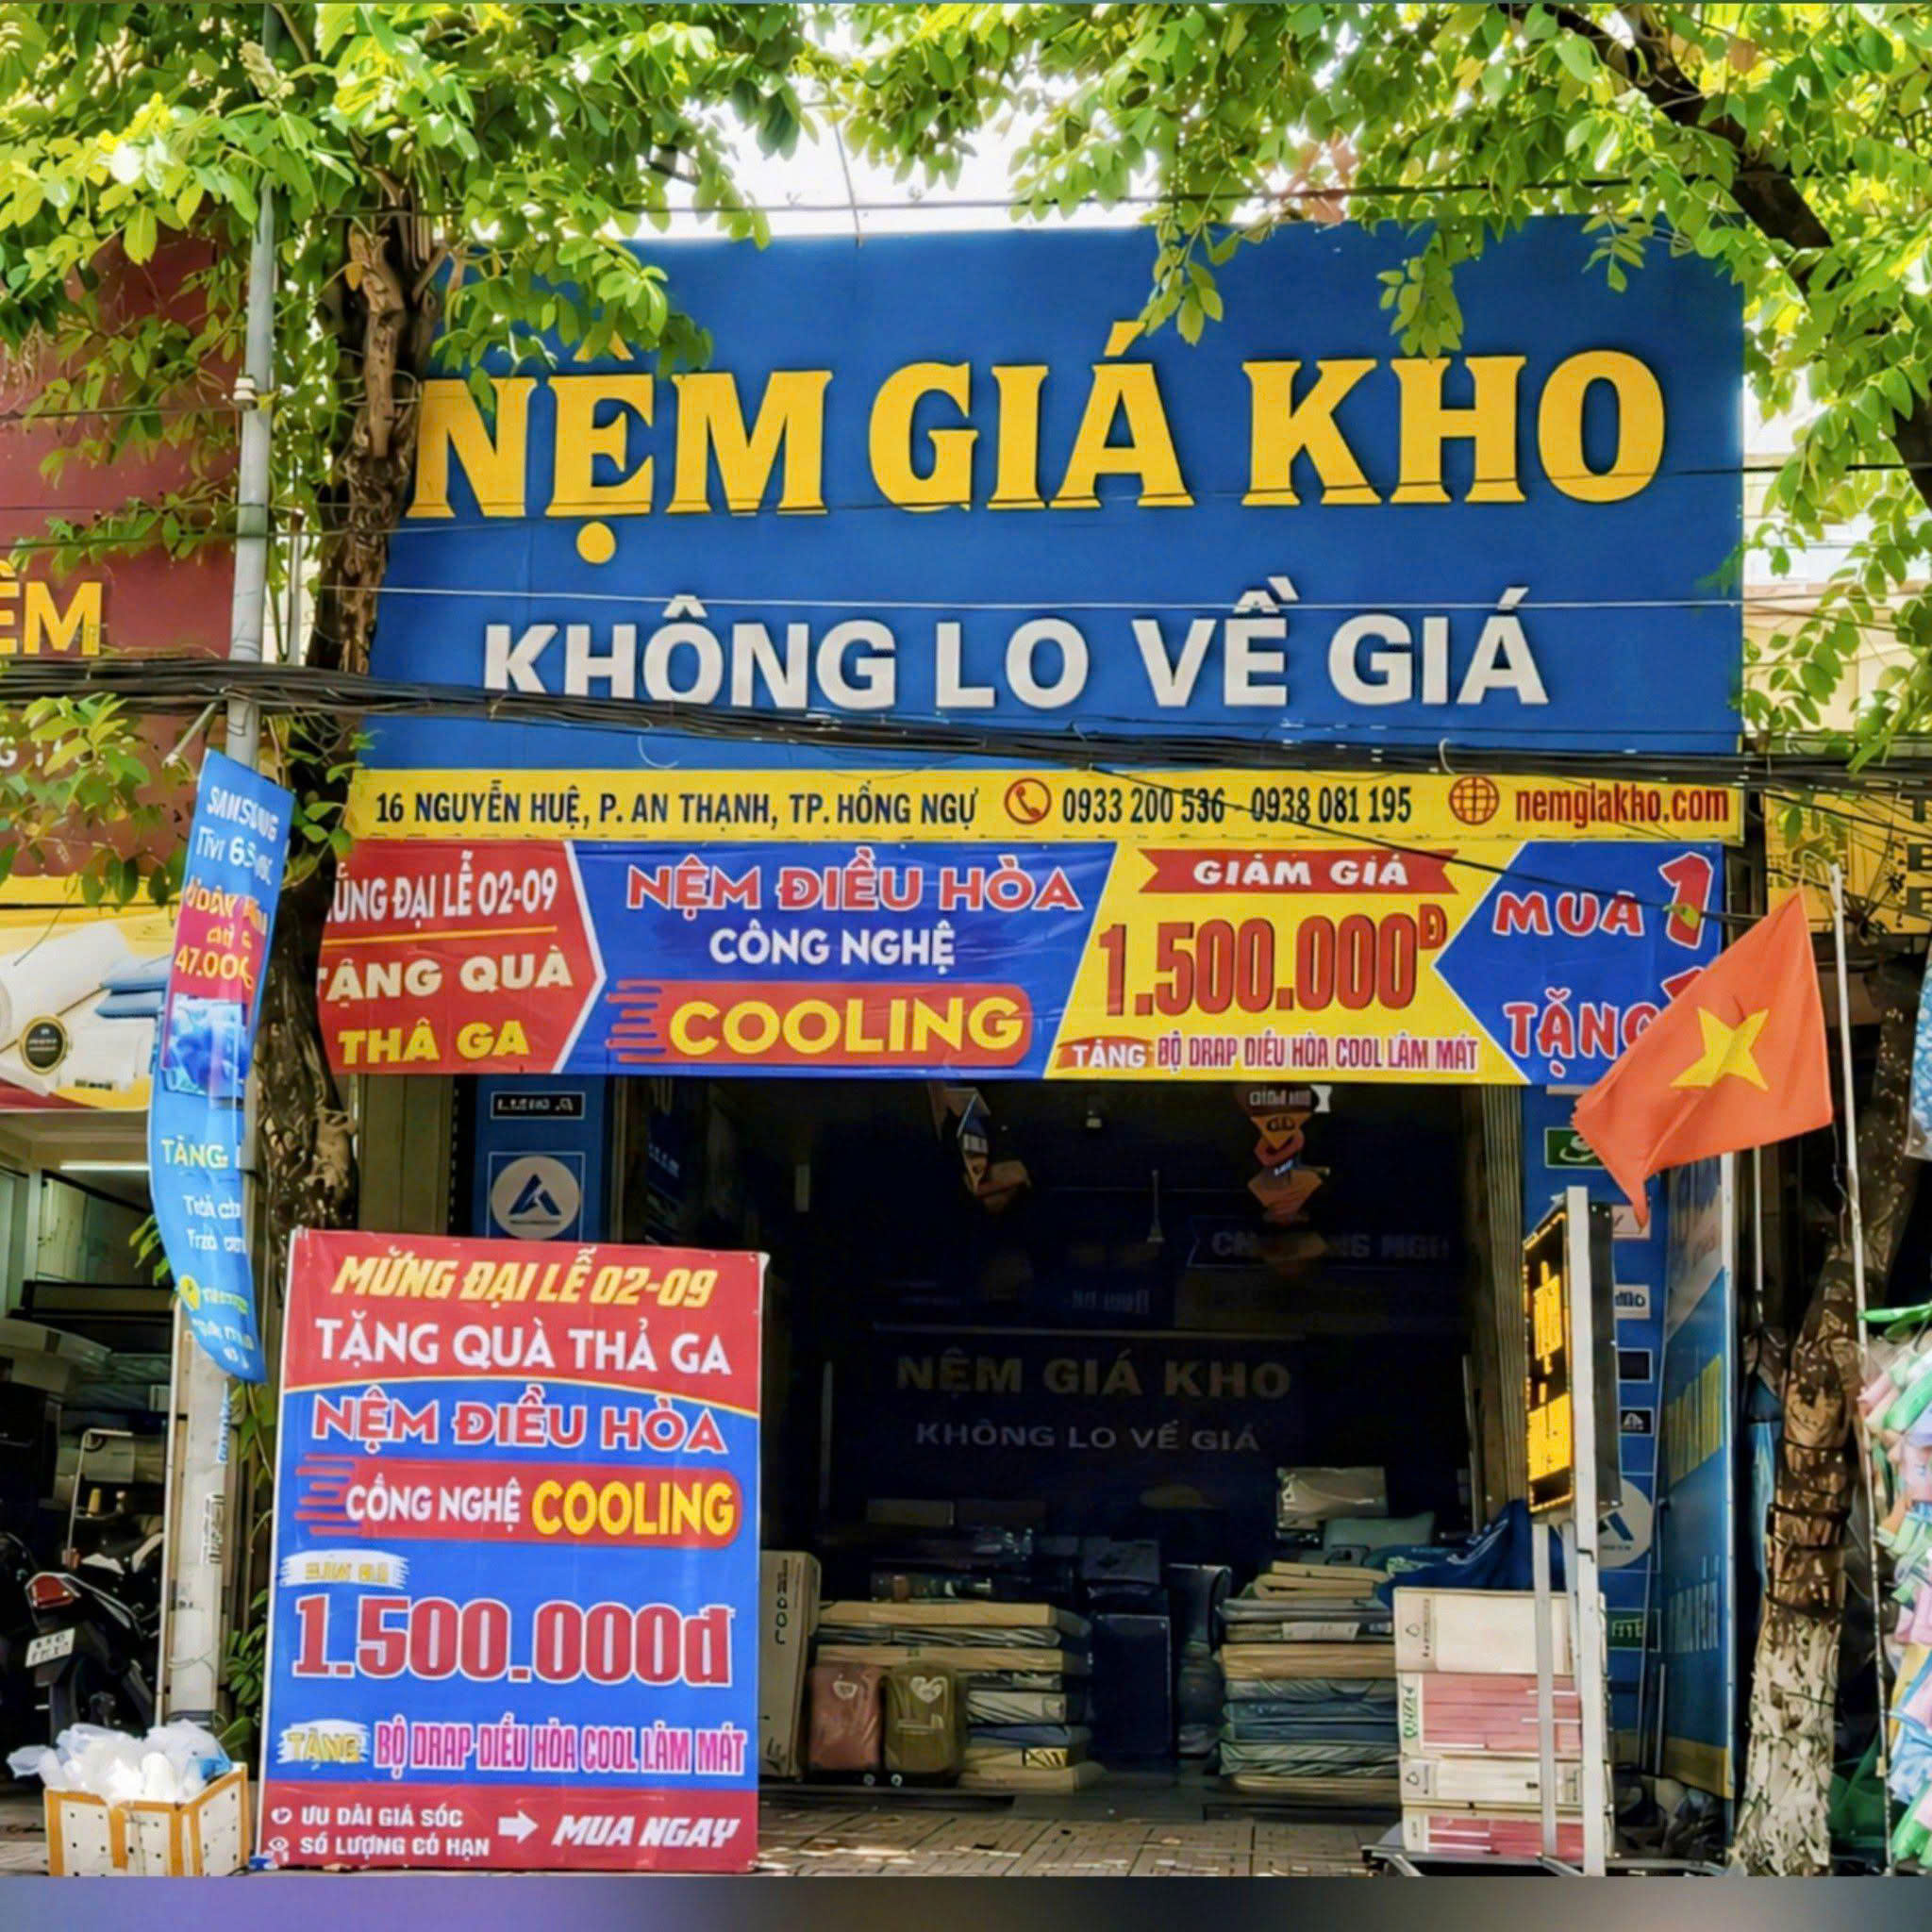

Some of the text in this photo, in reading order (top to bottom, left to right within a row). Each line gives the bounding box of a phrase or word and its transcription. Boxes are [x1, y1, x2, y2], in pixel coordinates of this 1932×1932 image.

[406, 320, 1665, 564] NỆM GIÁ KHO
[482, 575, 1550, 710] KHÔNG LO VỀ GIÁ
[376, 792, 405, 824] 16
[414, 779, 521, 824] NGUYỄN
[530, 785, 591, 830] HUỆ,
[599, 793, 623, 824] P.
[630, 793, 668, 824] AN
[789, 793, 830, 824] TP.
[838, 779, 911, 824] HỒNG
[920, 787, 978, 830] NGỰ
[1062, 787, 1123, 824] 0933
[1131, 787, 1173, 824] 200
[1180, 786, 1224, 824] 536
[1252, 786, 1310, 824] 0938
[1320, 786, 1360, 823] 081
[1368, 786, 1412, 823] 195
[1515, 782, 1729, 829] nemgiakho.com
[391, 874, 437, 929] ĐẠI
[442, 850, 474, 917] LỄ
[477, 868, 558, 917] 02-09
[625, 847, 1085, 921] NỆM ĐIỀU HÒA
[1192, 852, 1409, 887] GIẢM GIÁ
[1491, 890, 1645, 938] MUA
[1657, 851, 1714, 950] 1
[459, 945, 574, 993] QUÀ
[709, 919, 956, 974] CÔNG NGHỆ
[456, 1020, 530, 1059] GA
[669, 995, 1024, 1057] COOLING
[1188, 1035, 1239, 1069] DRAP
[1335, 1036, 1383, 1069] COOL
[331, 1244, 719, 1310] MỪNG ĐẠI LỄ 02-09
[315, 1310, 439, 1370] TẶNG
[453, 1317, 556, 1371] QUÀ
[568, 1318, 658, 1374] THẢ
[671, 1333, 733, 1376] GA
[894, 1346, 1292, 1399] NỆM GIÁ KHO
[312, 1384, 729, 1455] NỆM ĐIỀU HÒA
[915, 1418, 1056, 1448] KHÔNG
[1068, 1426, 1117, 1449] LO
[1191, 1423, 1260, 1452] GIÁ
[438, 1475, 523, 1533] NGHỆ
[531, 1478, 735, 1537] COOLING
[291, 1593, 737, 1689] 1.500.000đ
[374, 1713, 408, 1780] BỘ
[410, 1721, 475, 1770] DRAP
[581, 1724, 639, 1774] COOL
[377, 1802, 415, 1827] GIÁ
[551, 1813, 741, 1849] MUA NGAY
[445, 1837, 491, 1862] HẠN
